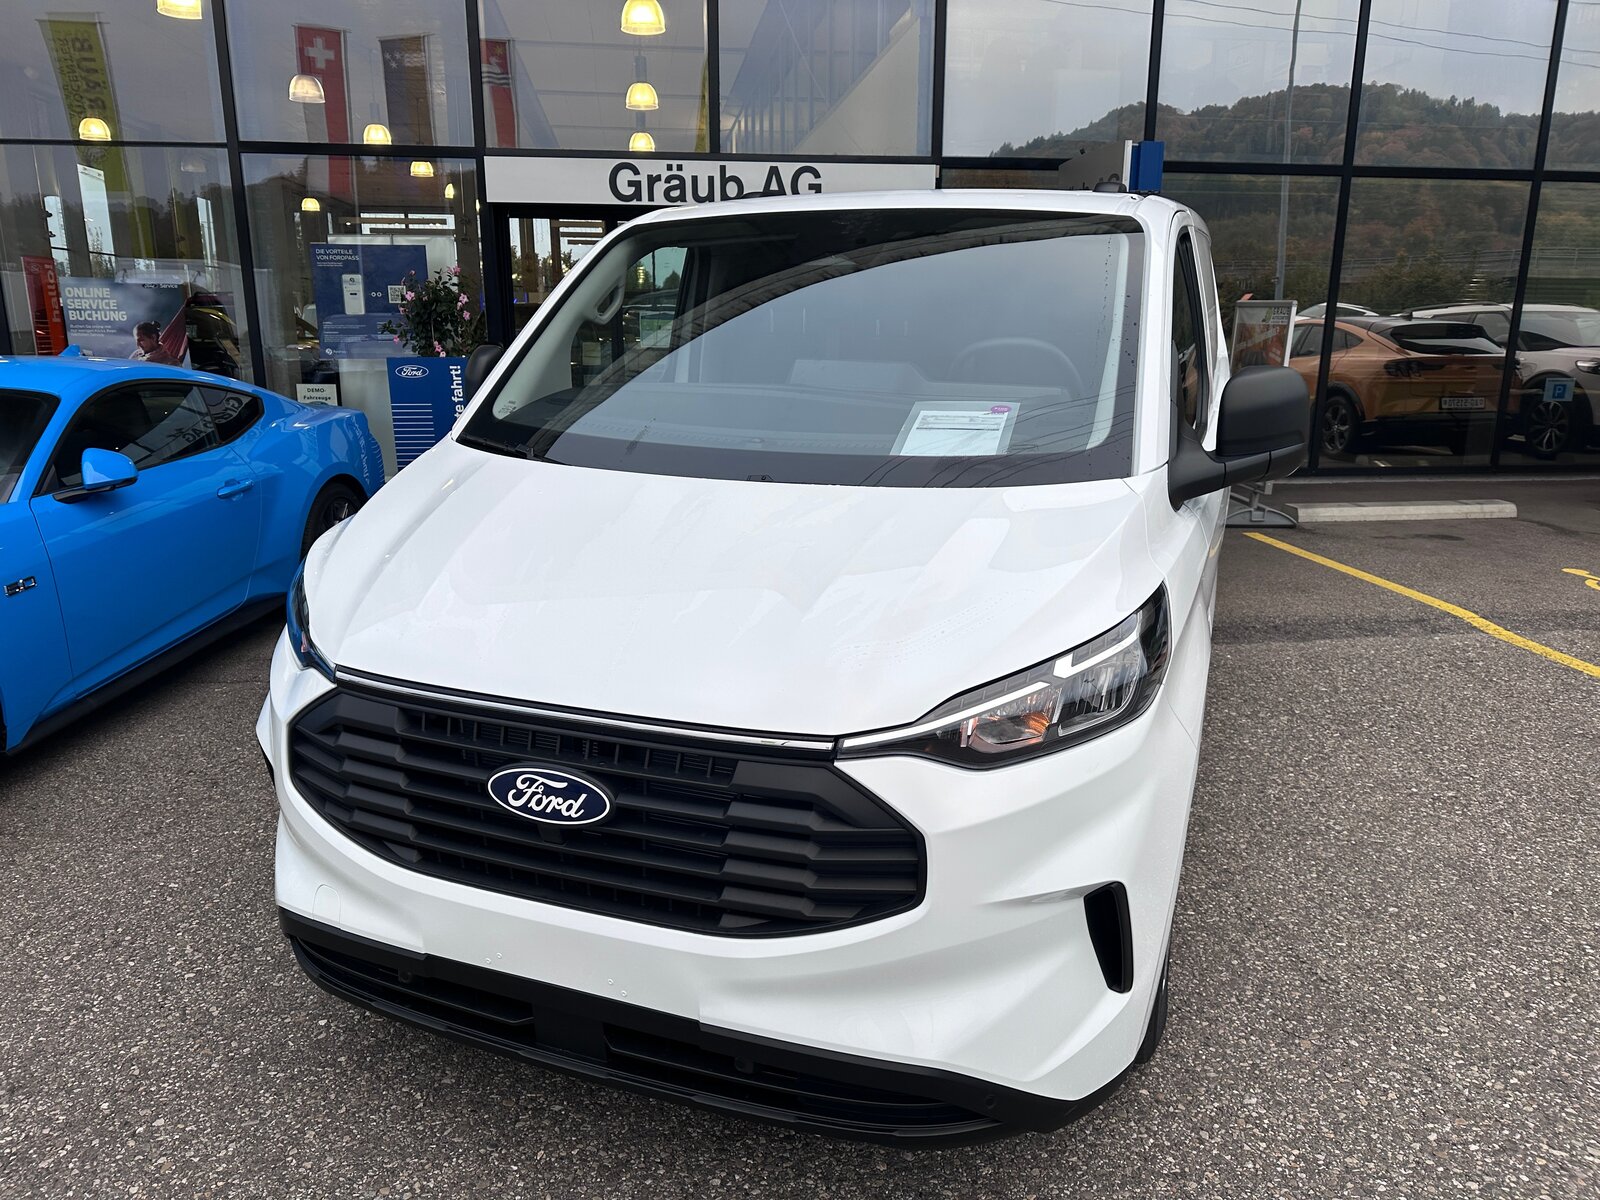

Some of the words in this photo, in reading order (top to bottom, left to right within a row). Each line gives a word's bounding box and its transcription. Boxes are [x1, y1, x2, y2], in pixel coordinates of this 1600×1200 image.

[608, 161, 744, 203] Gräub
[761, 165, 822, 195] AG
[44, 264, 61, 322] hallo!
[65, 287, 111, 298] ONLINE
[67, 299, 117, 310] SERVICE
[69, 310, 127, 321] BUCHUNG
[401, 367, 424, 377] Ford
[449, 365, 464, 402] fahrt!
[507, 774, 588, 818] Ford
